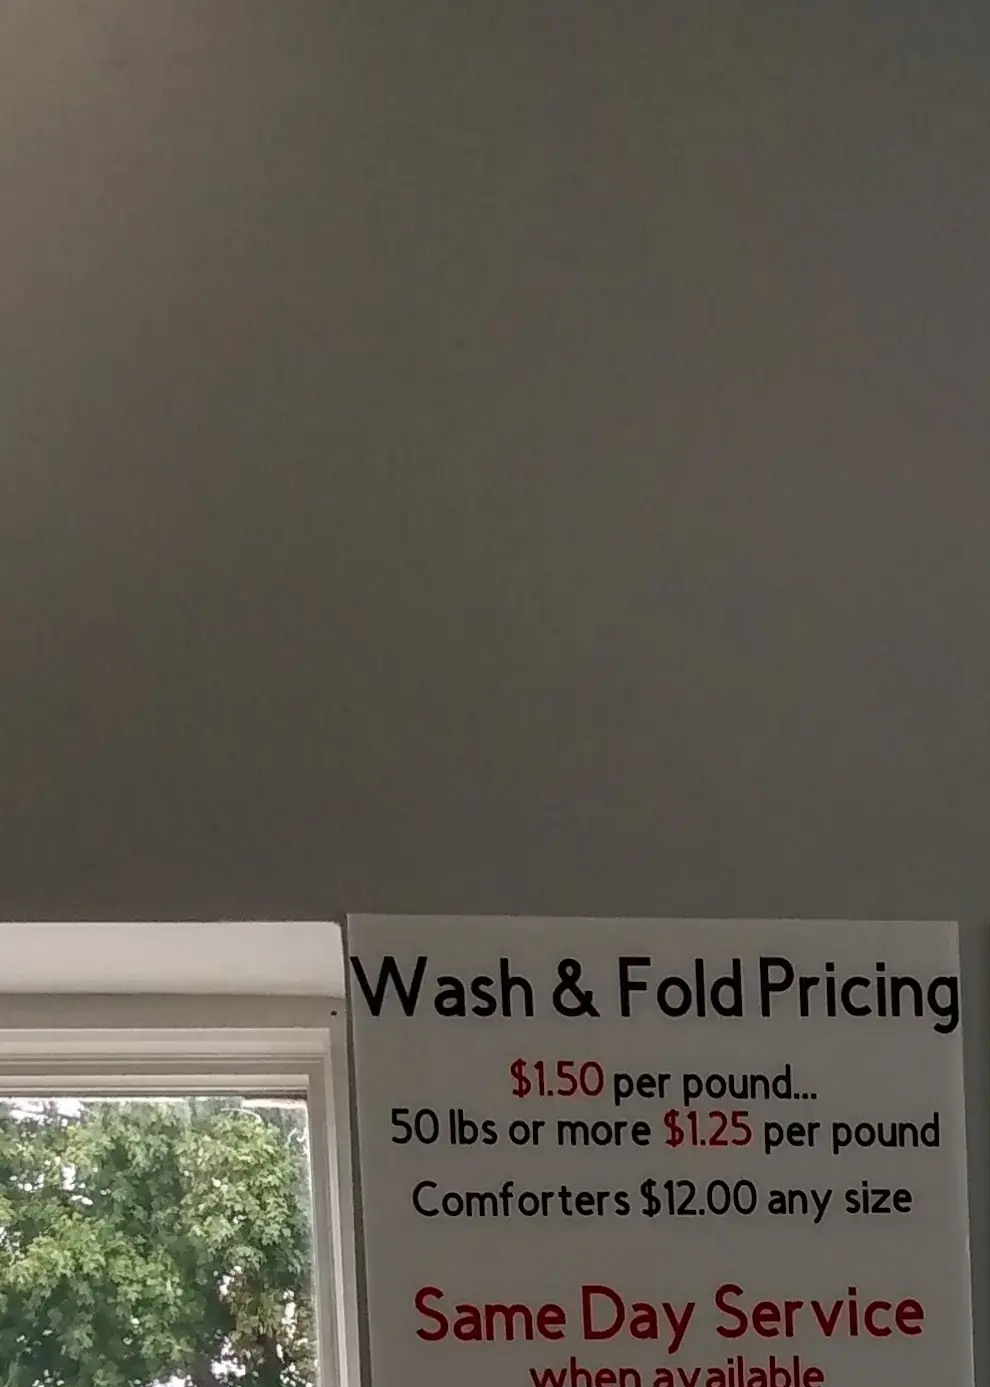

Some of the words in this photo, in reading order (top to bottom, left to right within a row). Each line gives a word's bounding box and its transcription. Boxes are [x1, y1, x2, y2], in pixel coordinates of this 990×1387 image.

[349, 955, 534, 1017] Wash
[552, 958, 601, 1018] &
[618, 956, 744, 1018] Fold
[759, 956, 960, 1034] Pricing
[510, 1058, 604, 1098] $1.50
[613, 1073, 672, 1107] per
[683, 1063, 817, 1107] pound...
[391, 1107, 440, 1145] 50
[449, 1108, 498, 1145] lbs
[508, 1120, 546, 1146] or
[557, 1120, 652, 1146] more
[663, 1108, 752, 1148] $1.25
[764, 1121, 821, 1155] per
[832, 1111, 940, 1155] pound
[412, 1180, 631, 1217] Comforters
[640, 1178, 757, 1218] $12.00
[767, 1189, 833, 1224] any
[845, 1180, 913, 1214] size
[414, 1286, 567, 1341] Same
[581, 1285, 696, 1355] Day
[714, 1283, 925, 1339] Service
